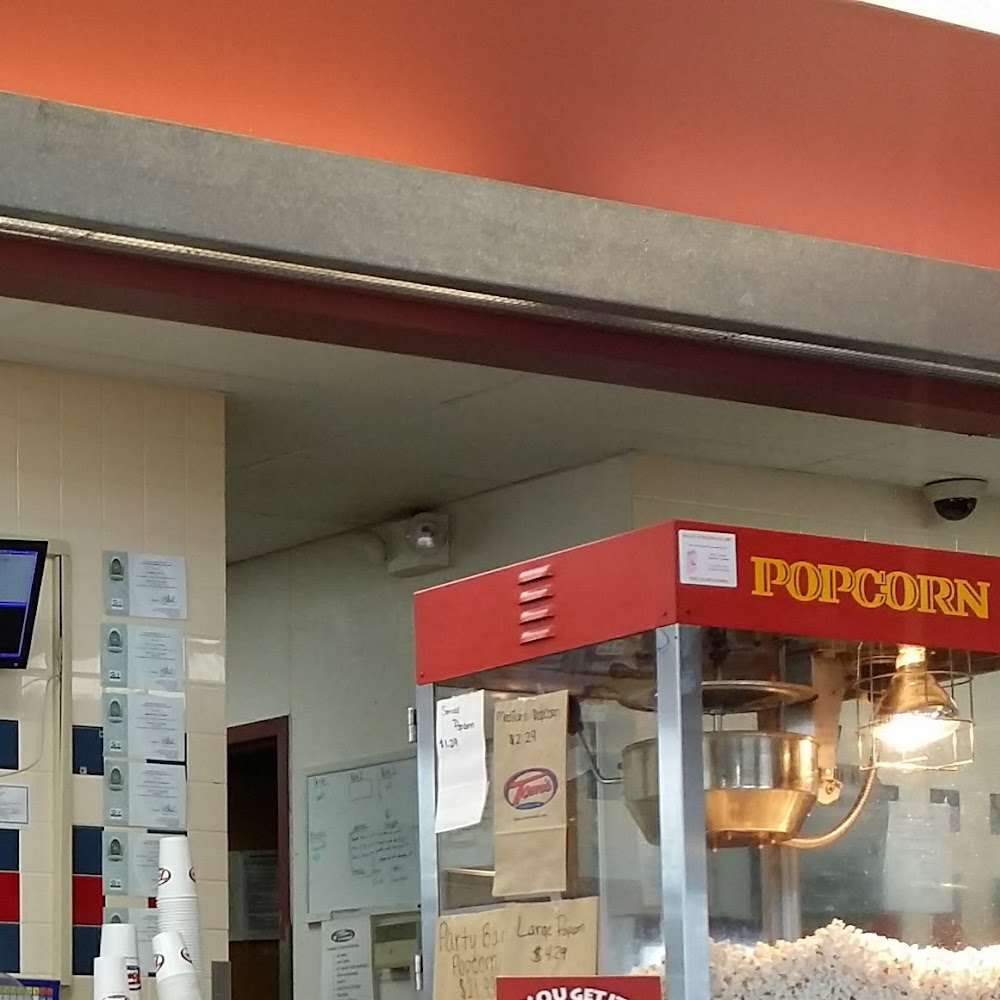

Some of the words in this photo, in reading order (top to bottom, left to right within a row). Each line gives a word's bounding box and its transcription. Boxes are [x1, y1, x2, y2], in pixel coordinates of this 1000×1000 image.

[750, 556, 990, 619] POPCORN
[439, 920, 476, 953] Party
[517, 915, 552, 938] Large
